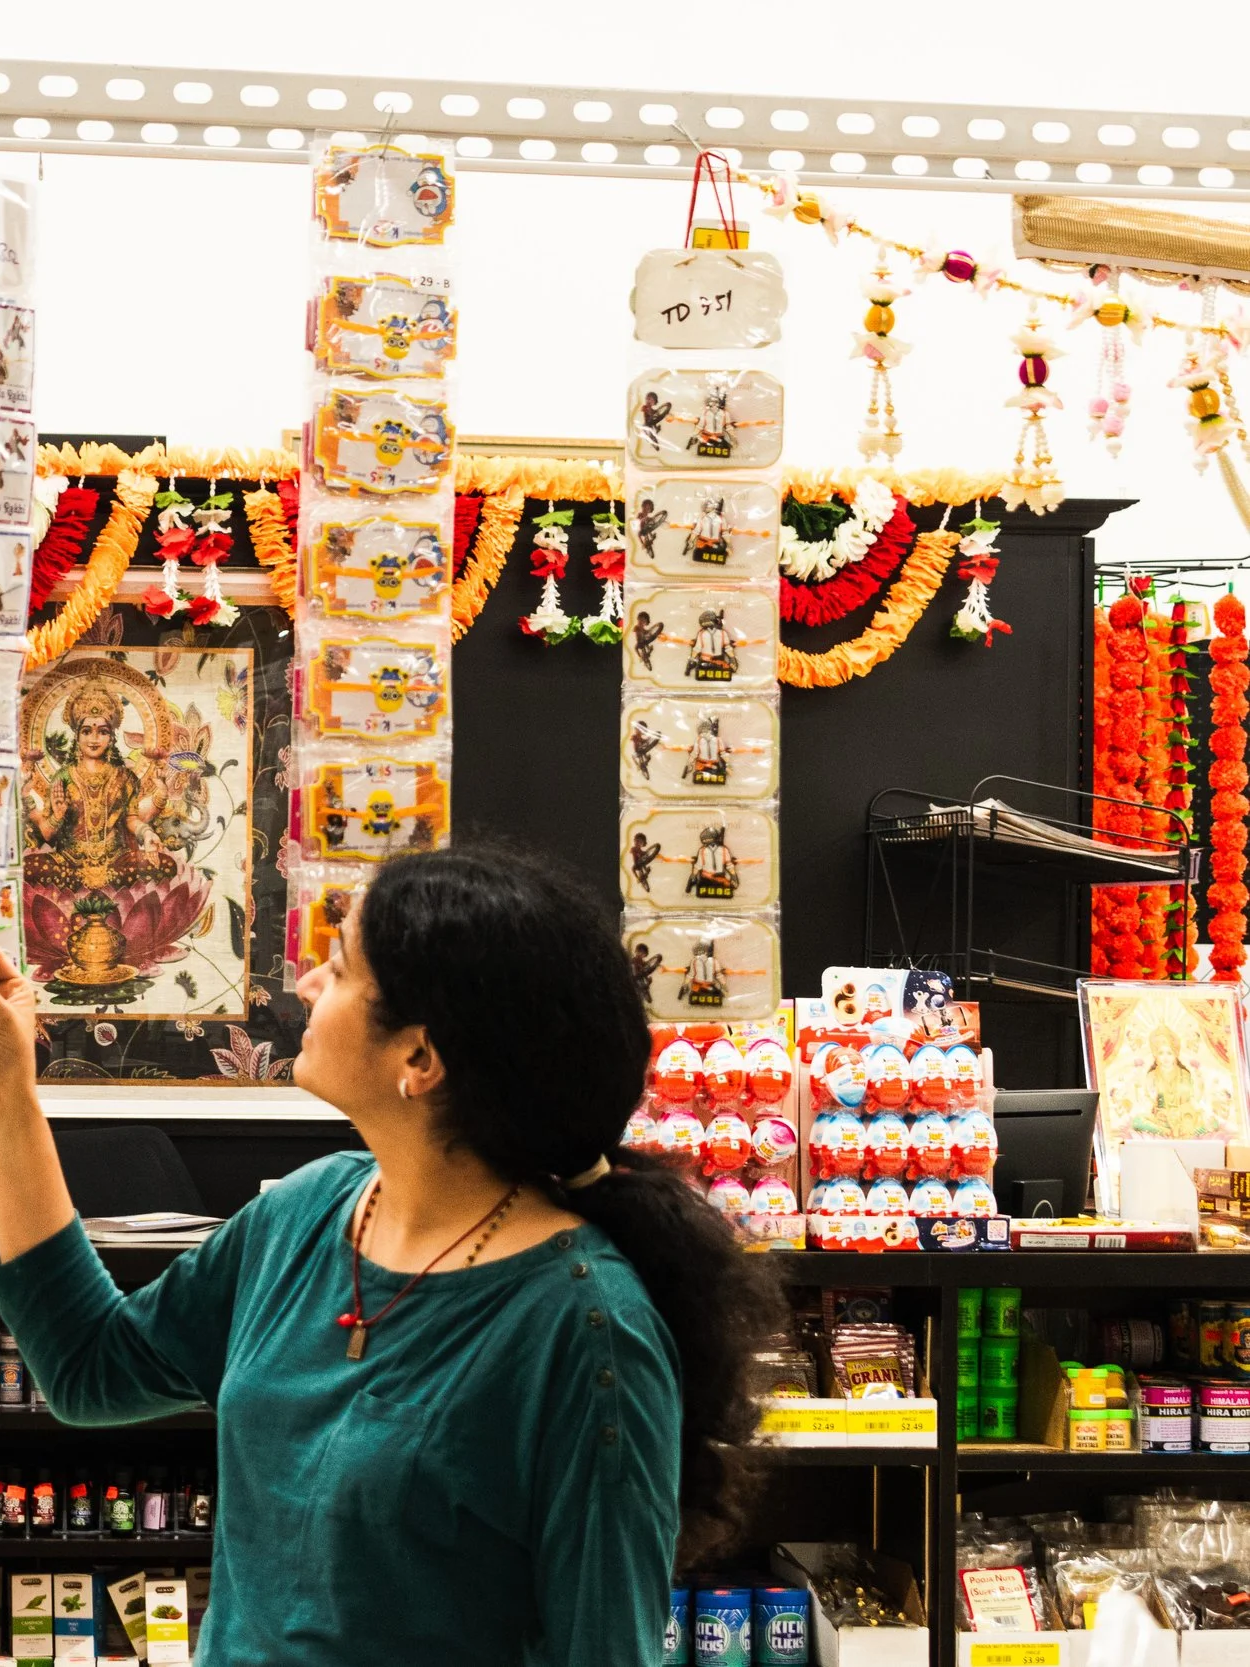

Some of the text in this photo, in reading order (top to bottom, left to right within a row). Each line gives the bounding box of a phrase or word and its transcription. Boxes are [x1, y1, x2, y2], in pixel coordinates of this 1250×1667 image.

[420, 276, 433, 287] 29
[443, 279, 450, 288] B
[660, 303, 691, 324] TD
[699, 446, 729, 457] PUBG
[701, 552, 725, 562] UBG
[699, 669, 731, 679] PUBG
[695, 773, 725, 783] PUBG
[700, 887, 732, 896] PUBG
[693, 995, 722, 1005] PUBG
[851, 1368, 900, 1385] CRANE
[1210, 1397, 1249, 1405] HIMALAYA
[1159, 1408, 1182, 1416] HIRA
[1207, 1408, 1250, 1416] HIRA MOT
[812, 1422, 835, 1430] $2.49
[901, 1422, 924, 1431] $2.49
[771, 1621, 803, 1633] KICK
[771, 1637, 804, 1649] CLICKS
[1022, 1656, 1045, 1664] $3.99
